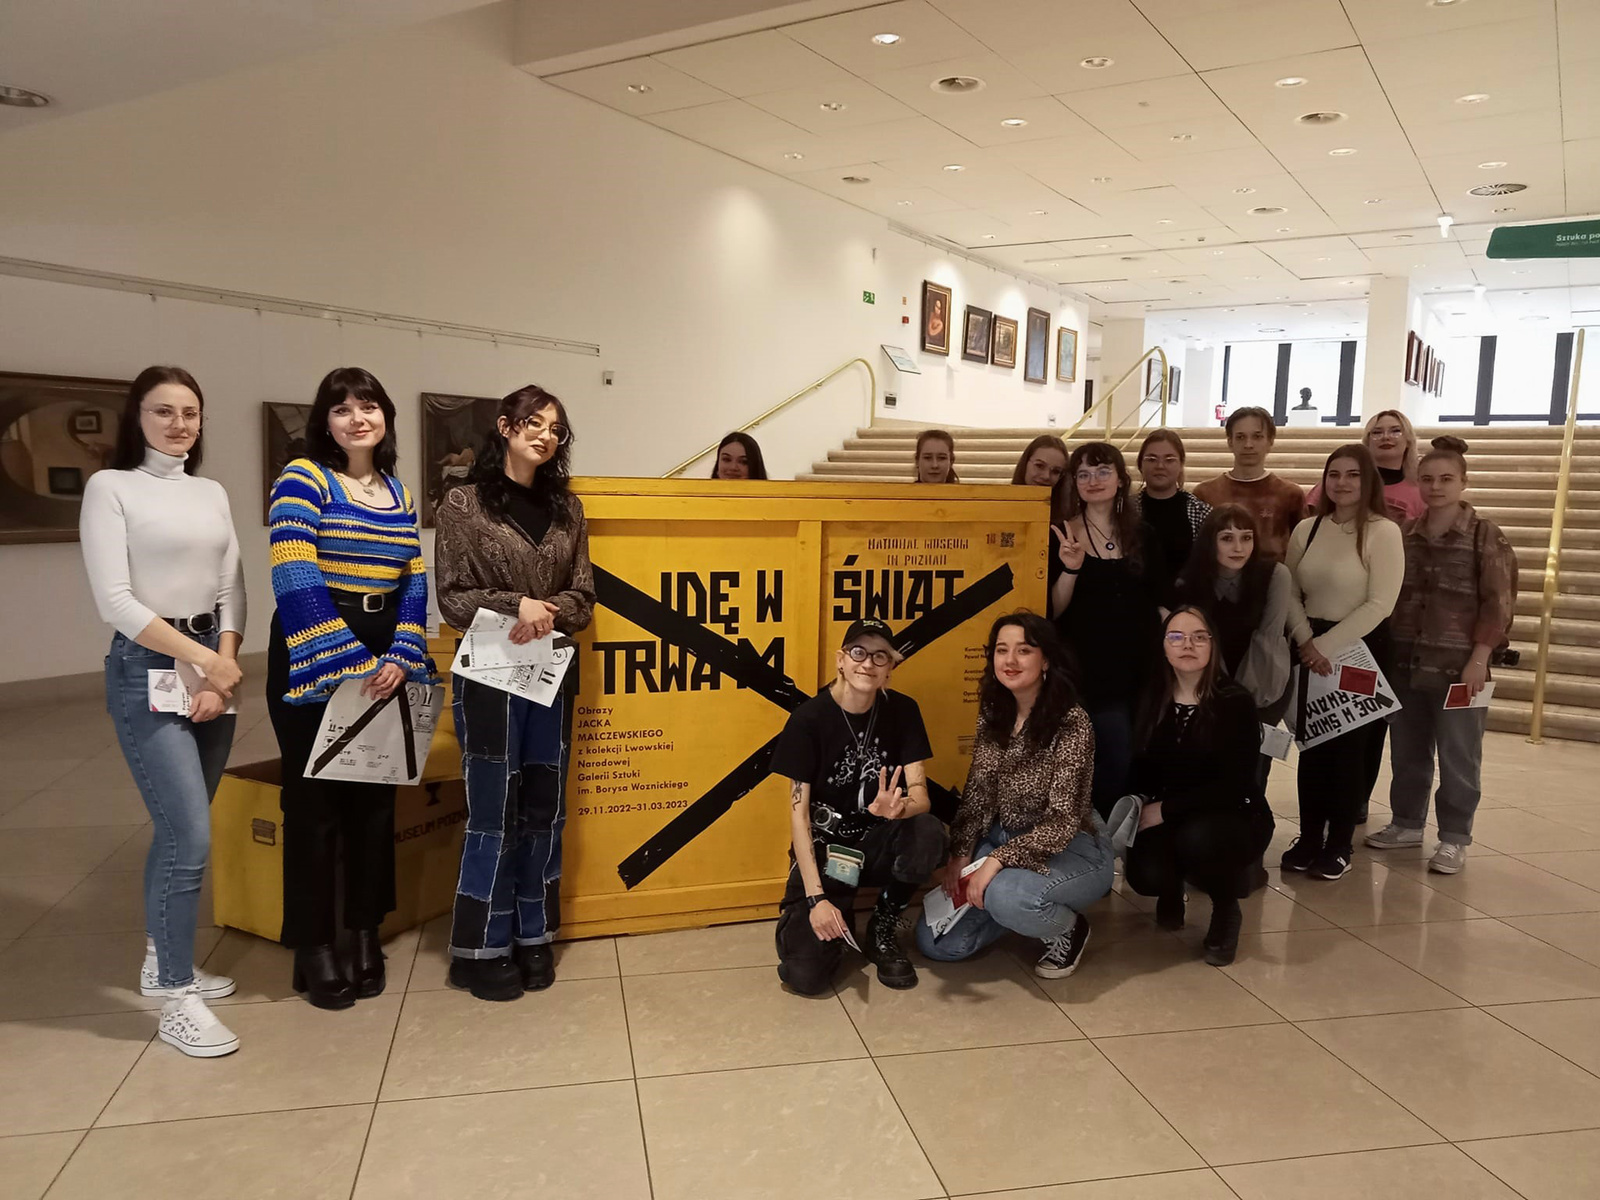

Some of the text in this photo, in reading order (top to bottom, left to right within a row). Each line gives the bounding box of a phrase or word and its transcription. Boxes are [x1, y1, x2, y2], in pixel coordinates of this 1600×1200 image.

[1556, 233, 1587, 242] Sztuka
[867, 538, 969, 550] NATIONAL MUSEUM
[887, 554, 898, 566] IN
[661, 555, 965, 635] IDĘ W ŚWIAT
[592, 637, 785, 695] TRWAM
[577, 706, 614, 716] Obrazy
[577, 719, 612, 729] JACKA
[577, 729, 664, 741] MALCZEWSKIEGO
[586, 744, 622, 755] kolekcji
[625, 741, 674, 752] Lwowskiej
[577, 757, 630, 768] Narodowej
[577, 770, 640, 782] Galerii Sztuki
[577, 786, 593, 795] im.
[595, 785, 628, 795] Borysa
